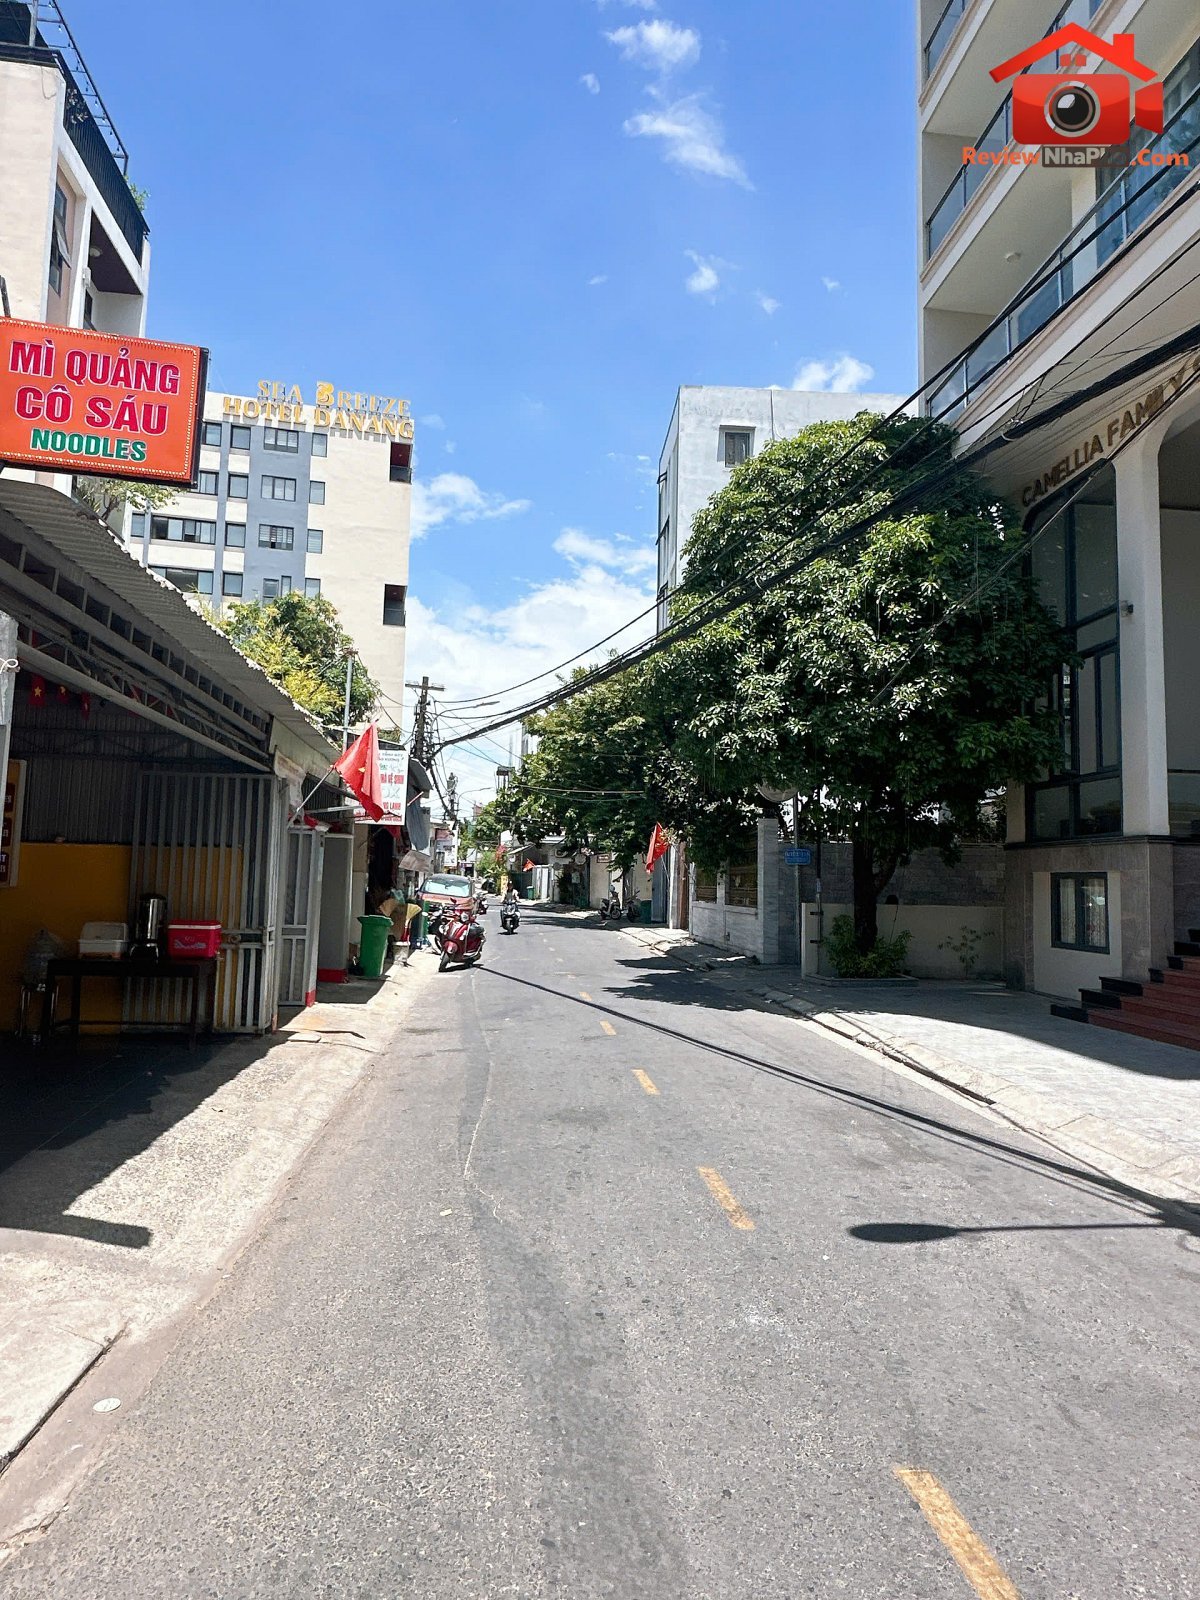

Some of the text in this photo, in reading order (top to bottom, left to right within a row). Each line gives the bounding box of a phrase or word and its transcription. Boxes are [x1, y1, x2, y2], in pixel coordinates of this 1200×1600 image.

[9, 339, 181, 395] MÌ QUẢNG
[15, 384, 169, 436] CÔ SÁU
[223, 396, 413, 439] HOTEL DANANG
[257, 379, 411, 416] SEA BREEZE
[30, 428, 147, 463] NOODLES
[1022, 434, 1104, 507] CAMELLIA
